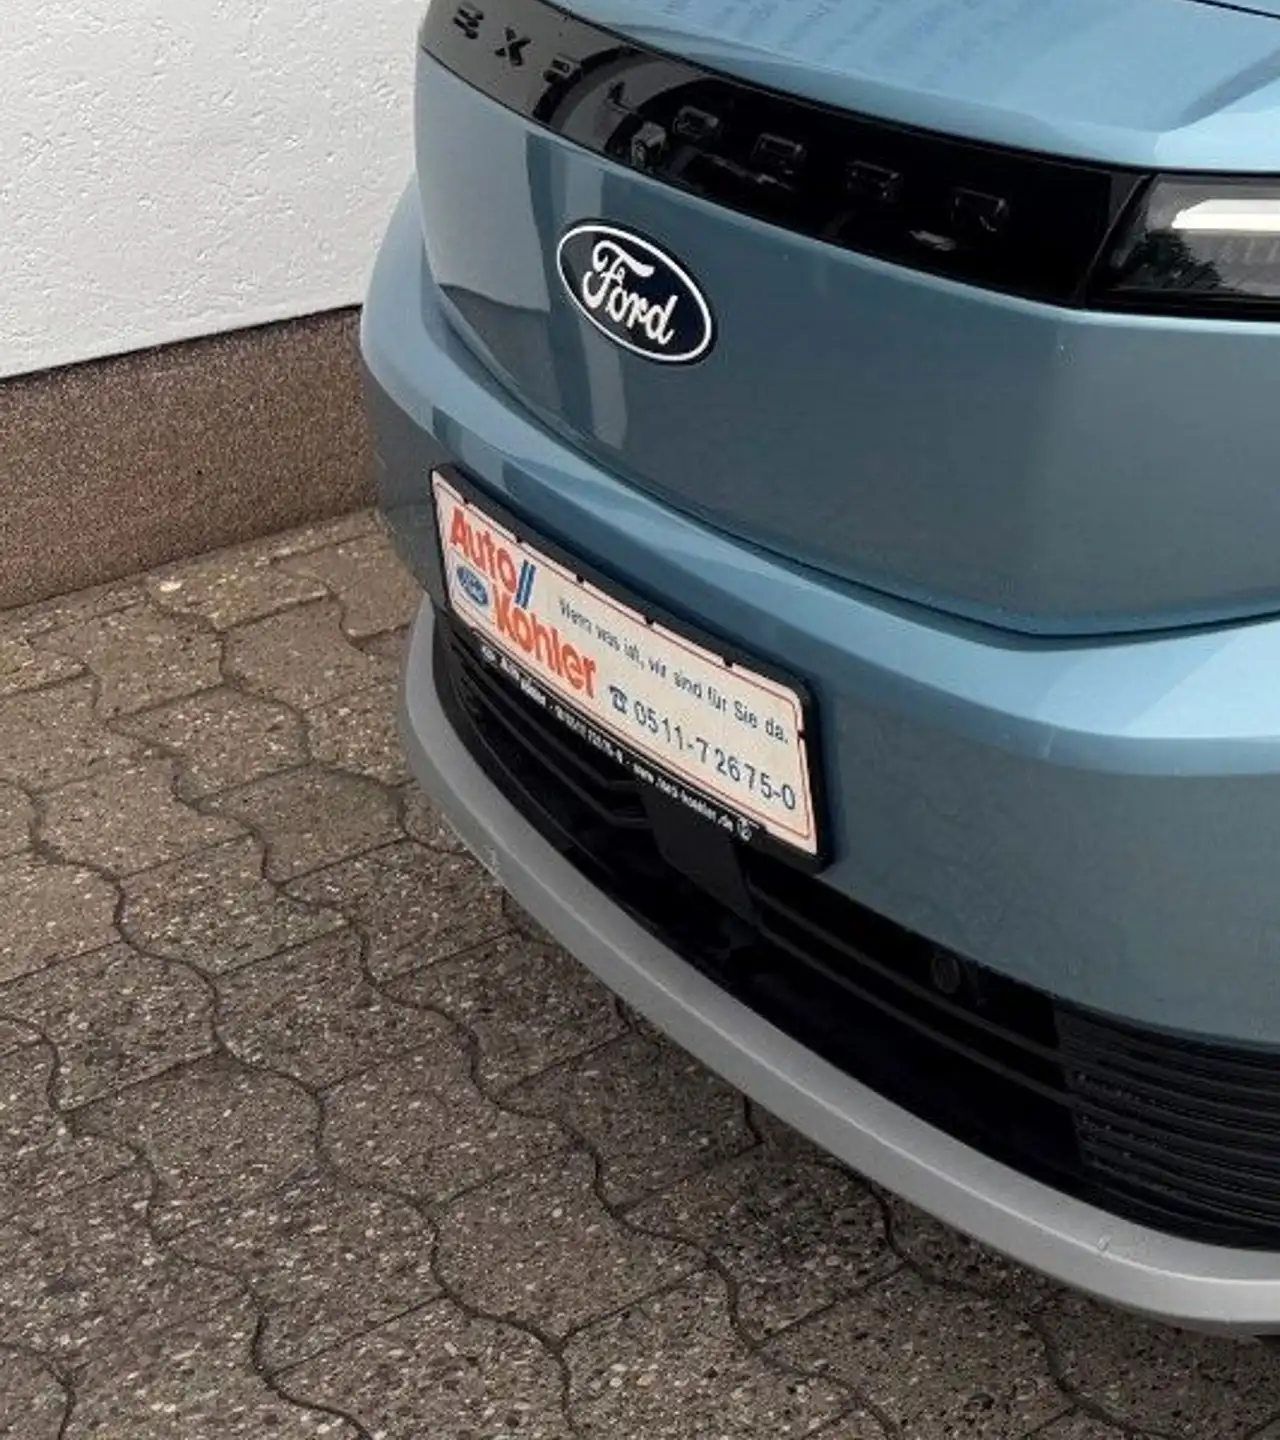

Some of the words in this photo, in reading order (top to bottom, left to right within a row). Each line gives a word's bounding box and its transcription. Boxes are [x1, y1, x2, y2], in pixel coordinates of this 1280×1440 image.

[582, 240, 679, 346] Ford
[451, 506, 517, 594] Auto
[595, 625, 621, 652] was
[648, 658, 667, 678] wir
[673, 672, 703, 699] sind
[707, 686, 727, 713] für
[733, 700, 759, 729] Sie
[765, 717, 789, 744] da.
